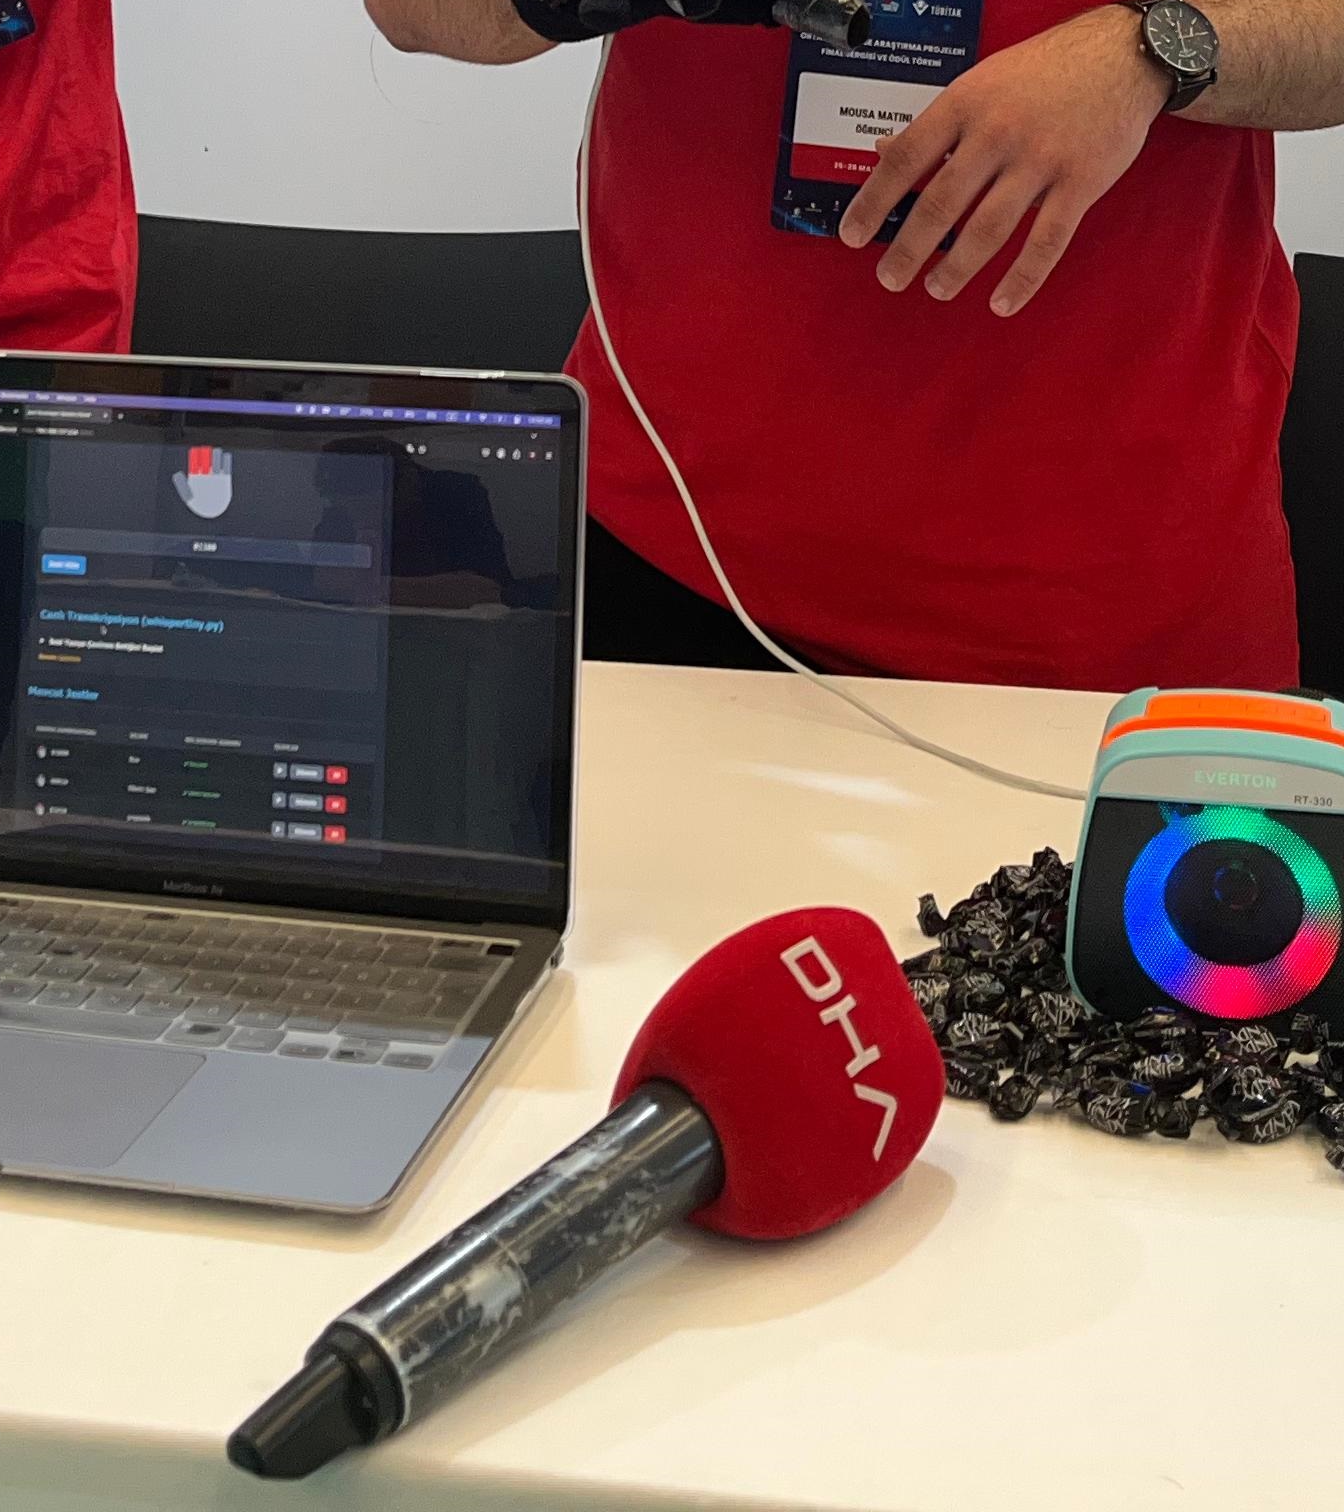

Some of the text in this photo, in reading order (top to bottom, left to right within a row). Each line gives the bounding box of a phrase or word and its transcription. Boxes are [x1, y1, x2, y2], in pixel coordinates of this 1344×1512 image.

[839, 106, 875, 120] MOUSA
[1193, 769, 1277, 789] EVERTON
[1293, 794, 1333, 808] RT-330
